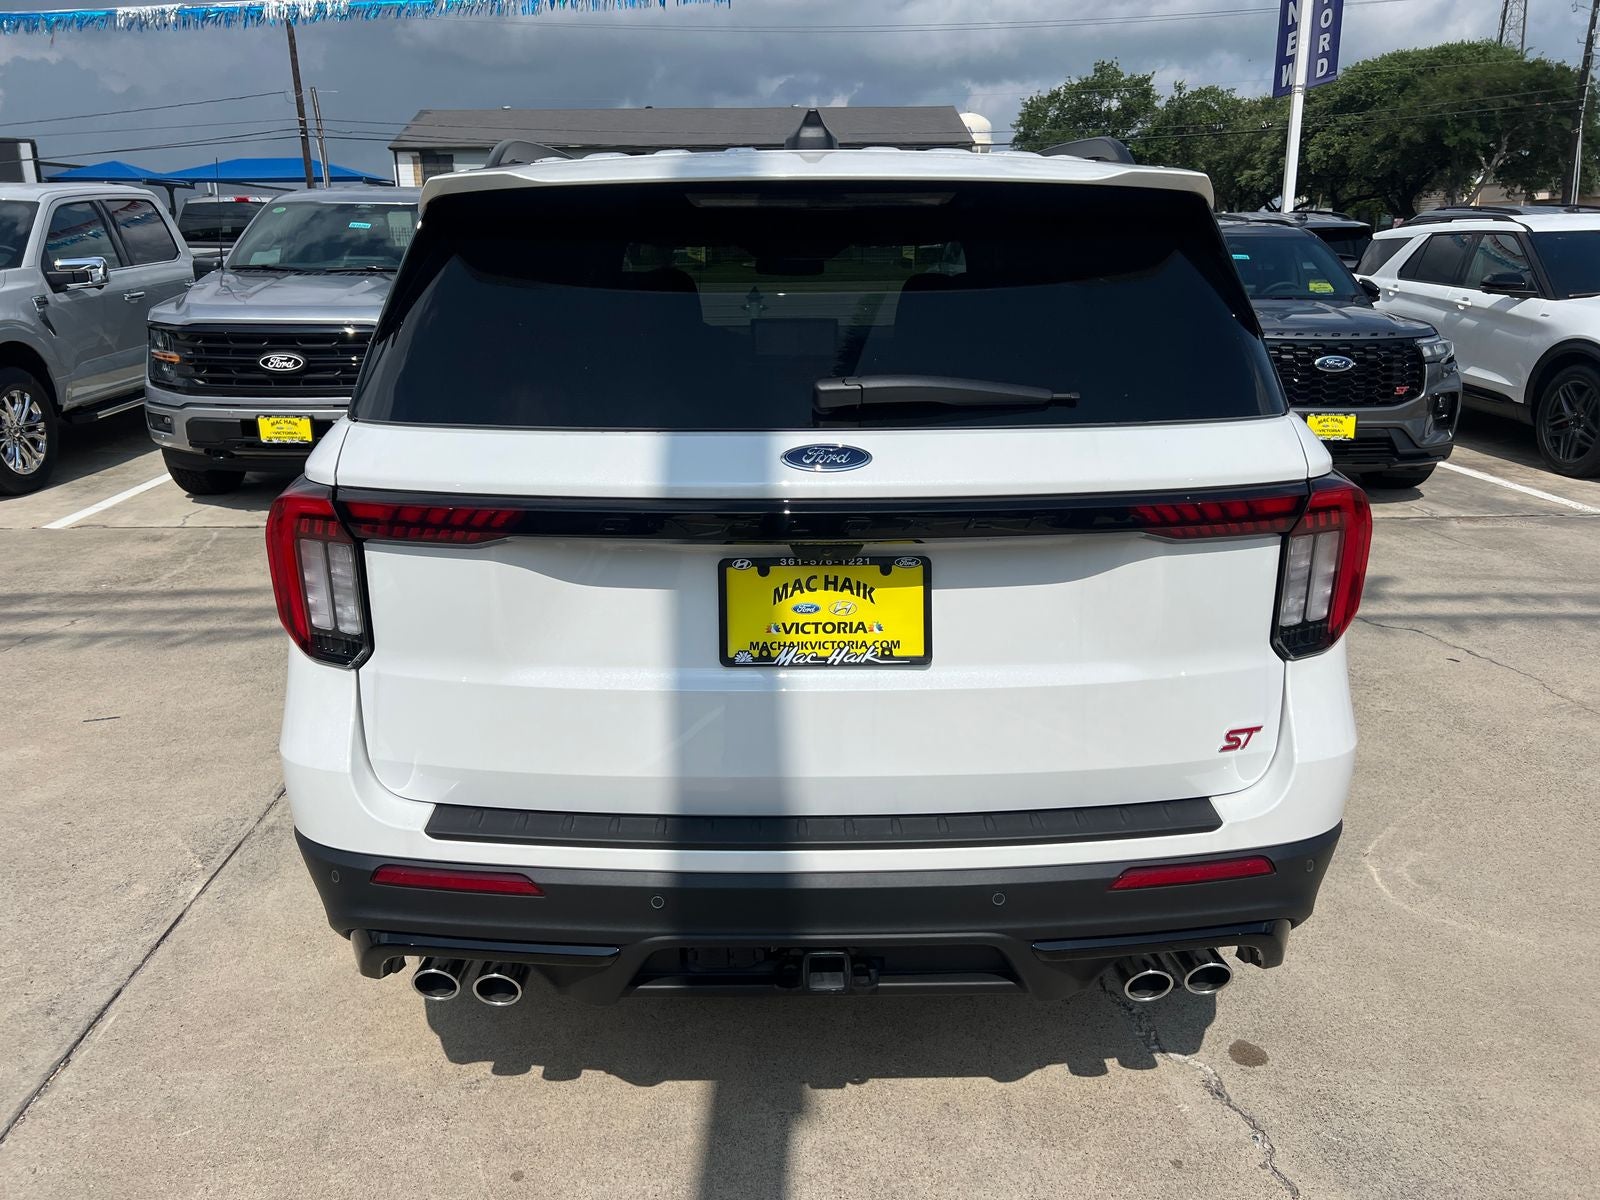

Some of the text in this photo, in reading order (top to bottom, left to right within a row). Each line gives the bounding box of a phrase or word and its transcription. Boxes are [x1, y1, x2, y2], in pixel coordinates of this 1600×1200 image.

[1315, 0, 1333, 78] ORD
[266, 355, 295, 369] Ford
[801, 446, 852, 464] Ford
[772, 574, 876, 606] MAC HAIK
[795, 603, 816, 614] Ford
[780, 621, 868, 635] VICTORIA
[749, 640, 901, 651] MACHAIKVICTORIA.COM
[774, 645, 886, 666] Mac Haik
[1218, 725, 1263, 753] ST
